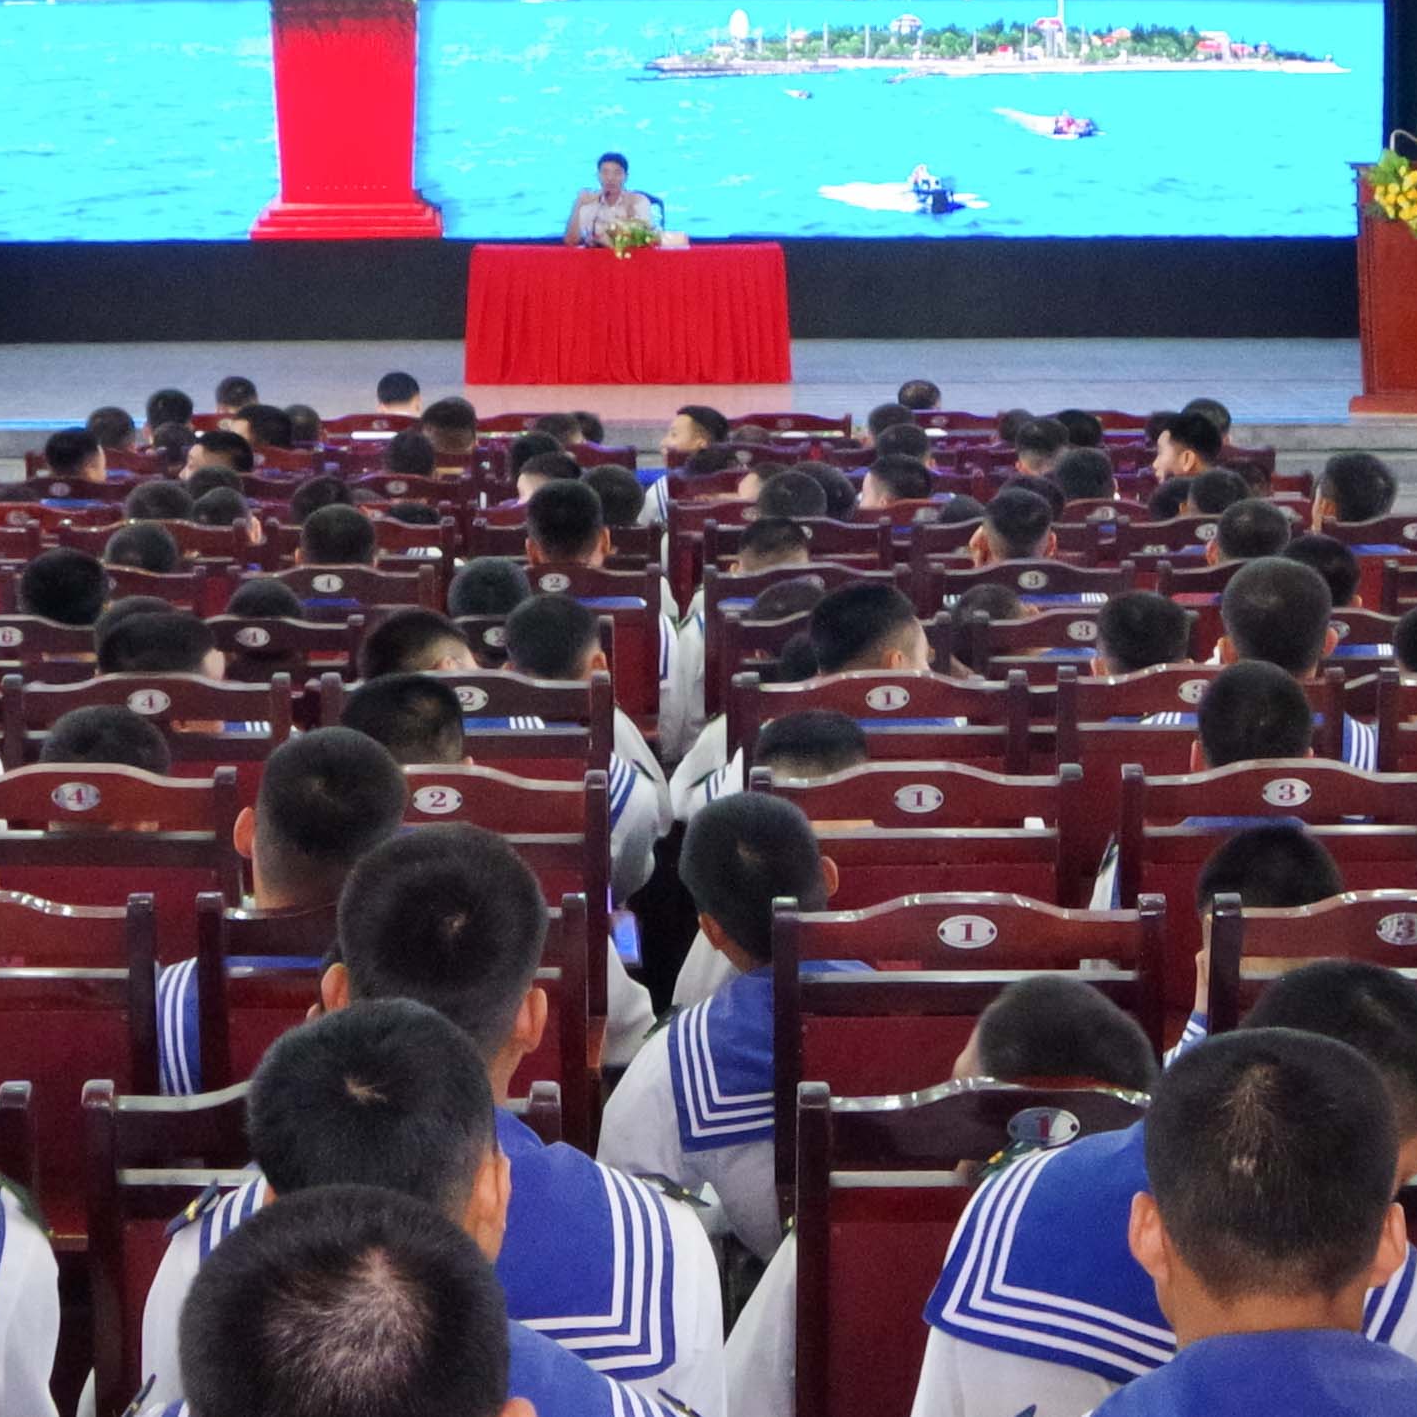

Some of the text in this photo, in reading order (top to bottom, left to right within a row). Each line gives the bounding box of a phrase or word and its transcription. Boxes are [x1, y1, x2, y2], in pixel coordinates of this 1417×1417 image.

[549, 577, 561, 589] 2
[1028, 573, 1039, 586] 3
[1078, 624, 1091, 638] 3
[140, 694, 155, 709] 4
[460, 690, 475, 705] 2
[882, 690, 893, 706] 1
[67, 788, 84, 805] 4
[429, 791, 448, 808] 2
[912, 790, 924, 808] 1
[1278, 783, 1297, 801] 3
[959, 922, 974, 943] 1
[1394, 917, 1416, 940] 3
[1036, 1113, 1055, 1141] 1
